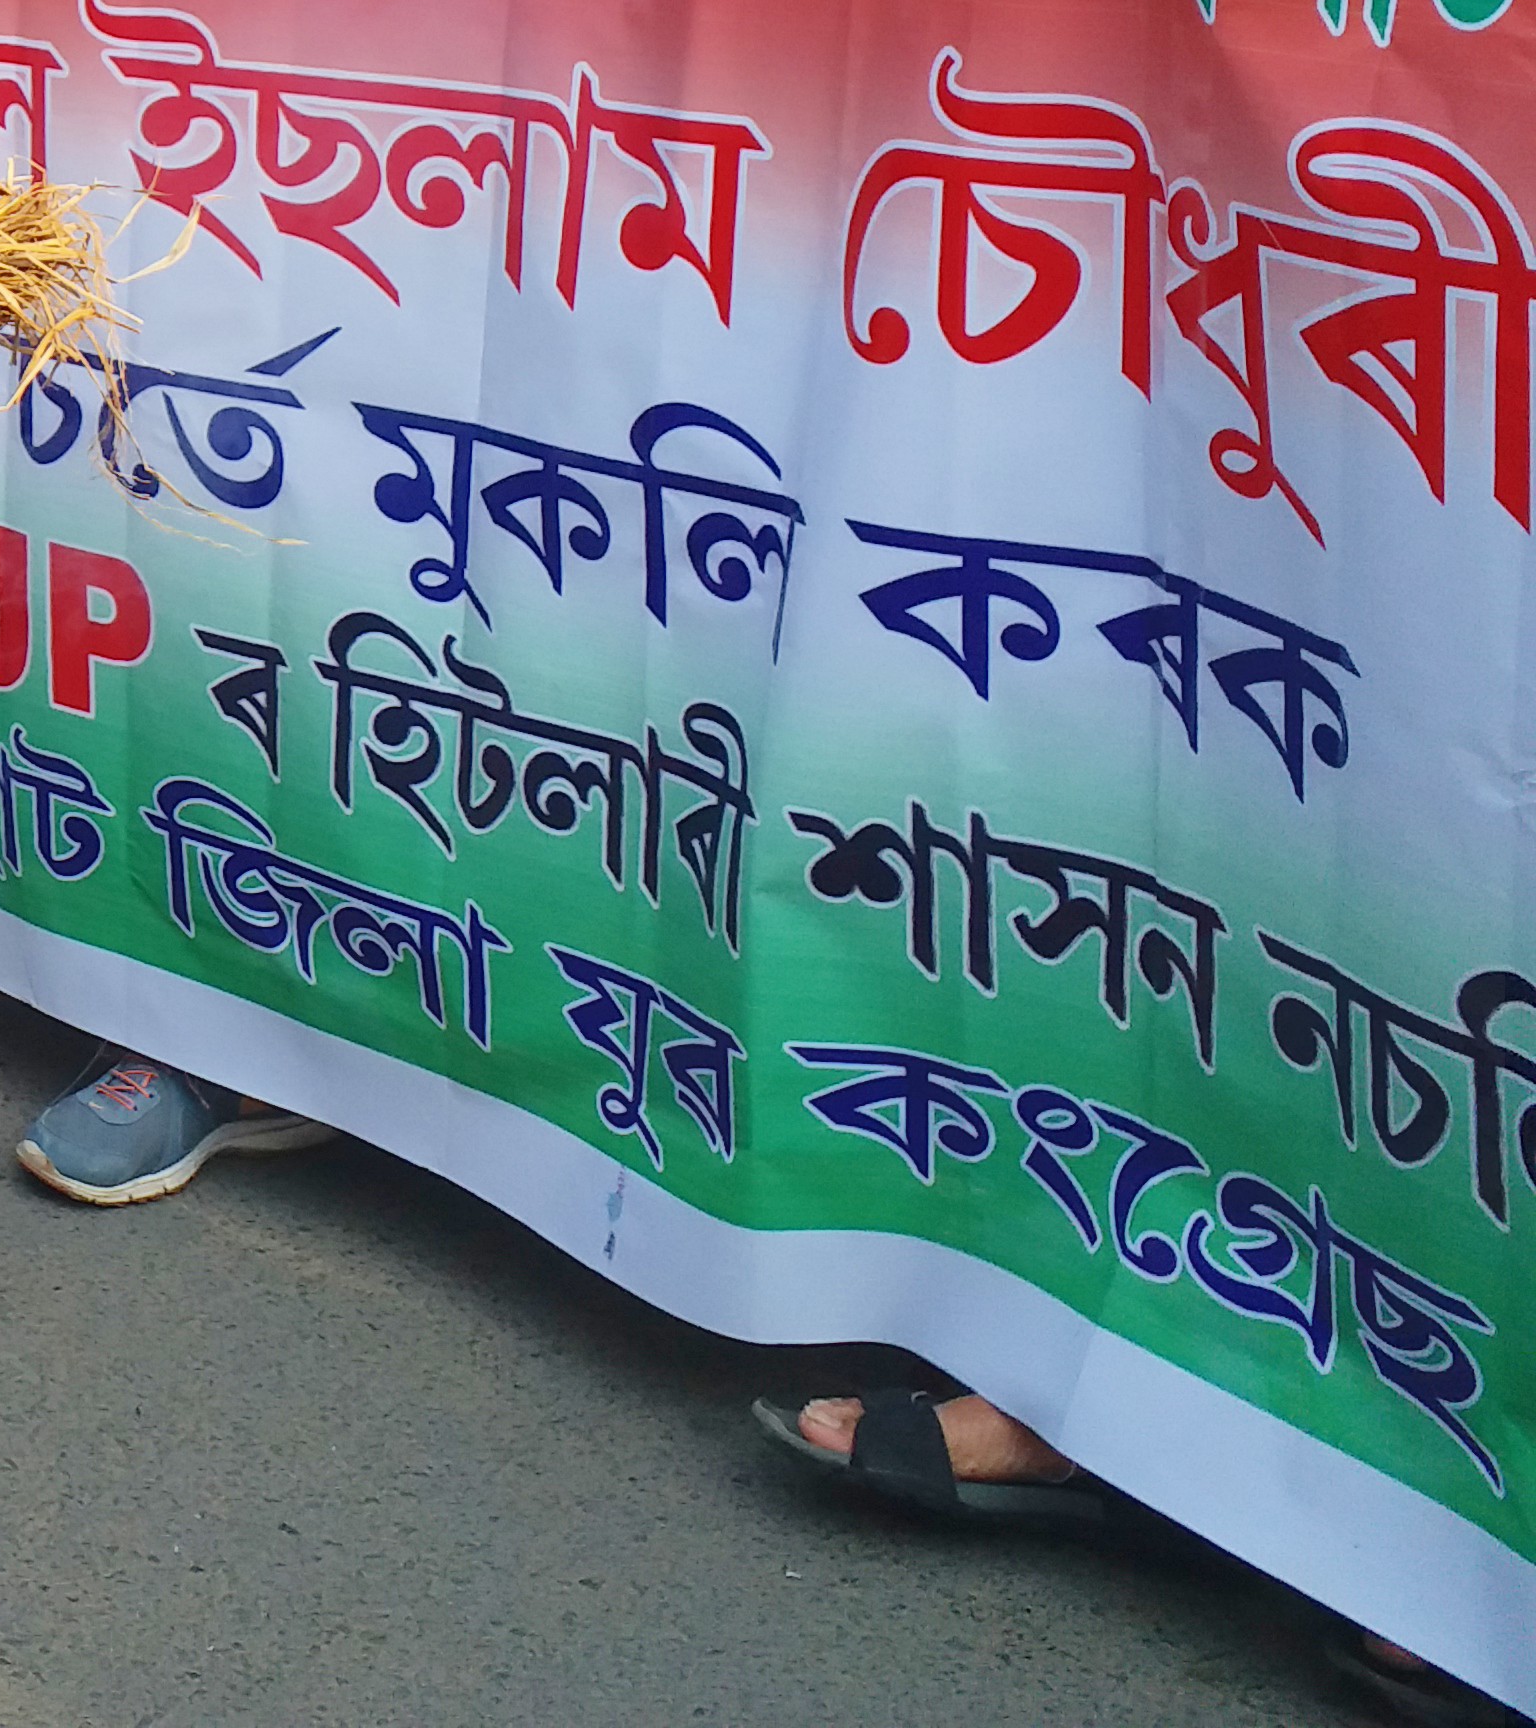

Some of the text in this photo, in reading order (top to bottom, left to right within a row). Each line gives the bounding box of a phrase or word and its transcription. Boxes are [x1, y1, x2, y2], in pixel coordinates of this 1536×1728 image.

[351, 400, 806, 668] মুকলি
[844, 517, 1362, 804] কৰক
[191, 623, 290, 784] ৰ
[309, 610, 760, 960] হিটলাৰী
[785, 796, 1229, 1074] শাসন
[139, 774, 513, 1054] জিলা
[783, 1041, 1506, 1498] কংগ্ৰেছ
